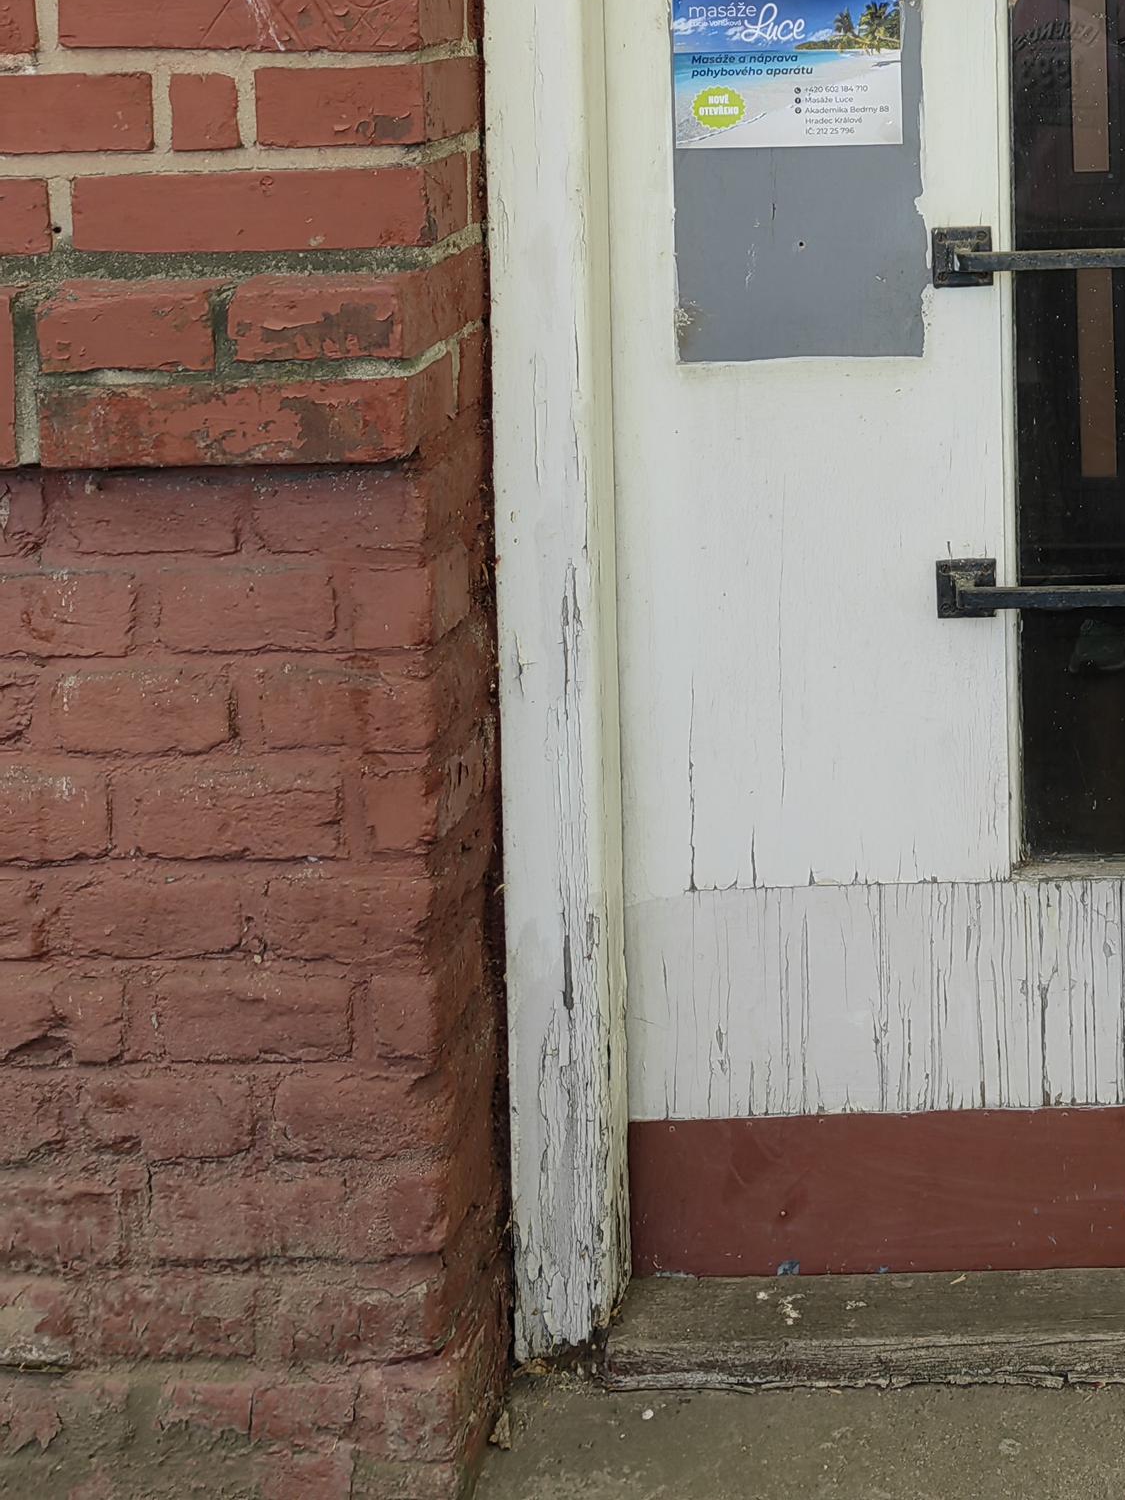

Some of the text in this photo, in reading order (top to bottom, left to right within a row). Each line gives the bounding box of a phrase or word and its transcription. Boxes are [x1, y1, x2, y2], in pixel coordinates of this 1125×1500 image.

[689, 2, 805, 42] masáže Luce
[691, 53, 798, 65] Masáže a náprava
[691, 65, 813, 78] pohybového aparátu
[834, 115, 863, 123] Králové
